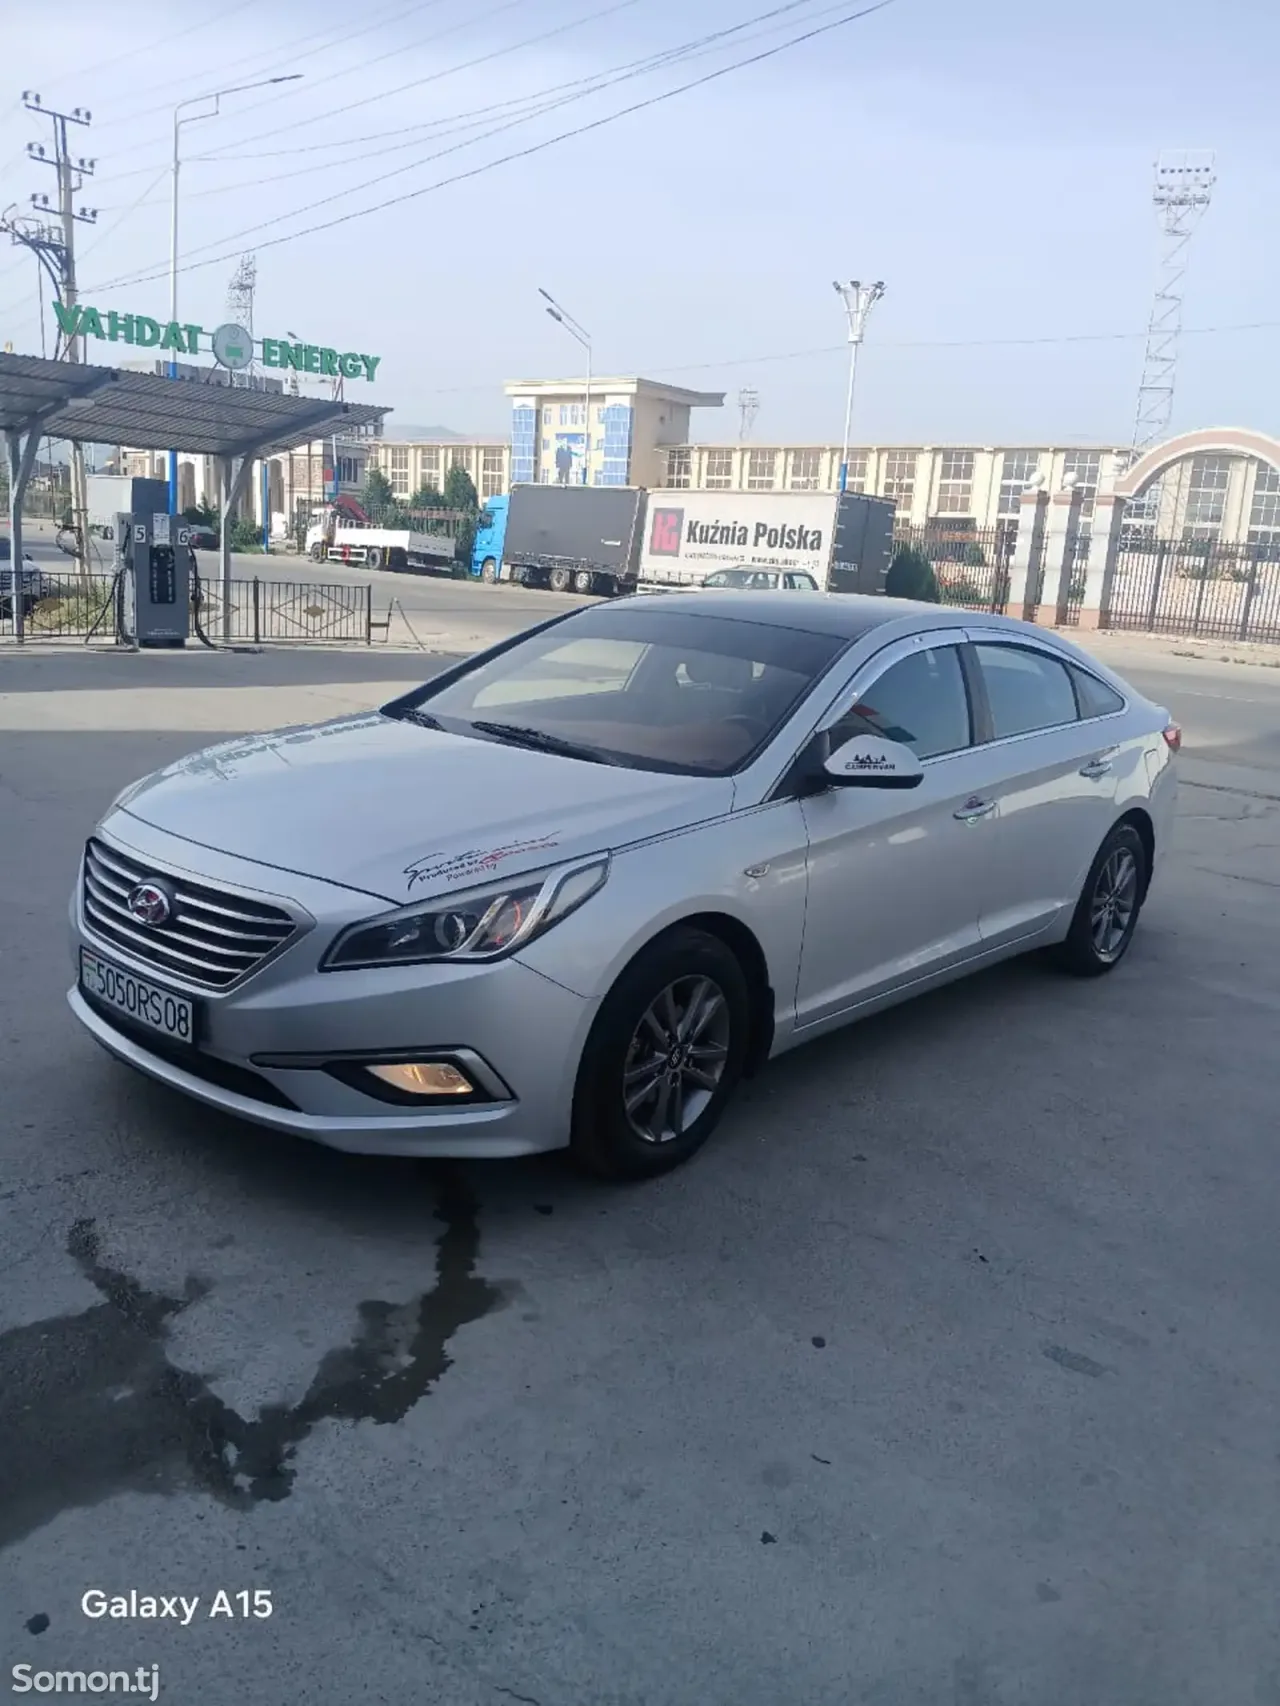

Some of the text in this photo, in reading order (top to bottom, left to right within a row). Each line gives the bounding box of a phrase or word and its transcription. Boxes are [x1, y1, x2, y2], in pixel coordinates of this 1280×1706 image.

[52, 301, 381, 382] VAHDAT ENERGY
[135, 527, 145, 541] 5
[179, 529, 188, 543] 6
[686, 520, 823, 552] Kuźnia Polska
[96, 962, 190, 1038] 5050RS08
